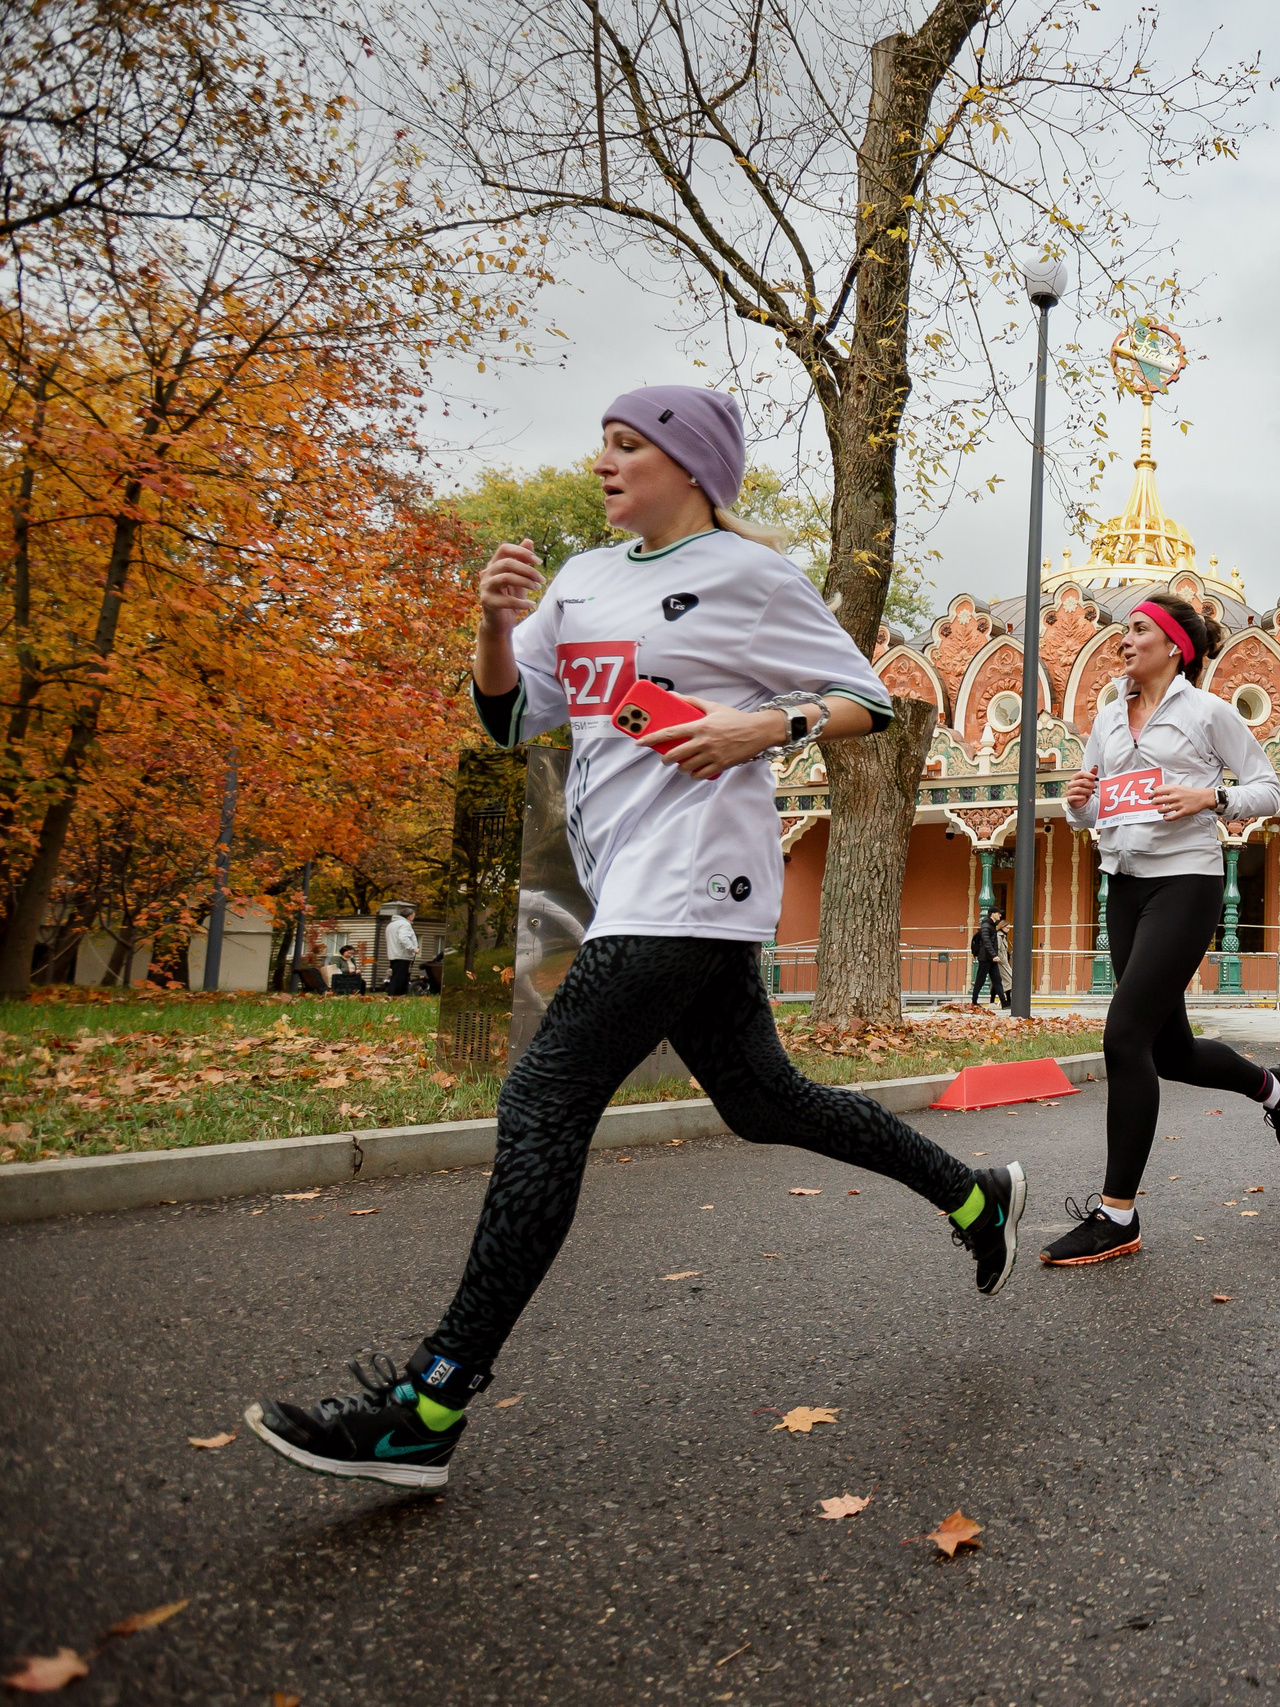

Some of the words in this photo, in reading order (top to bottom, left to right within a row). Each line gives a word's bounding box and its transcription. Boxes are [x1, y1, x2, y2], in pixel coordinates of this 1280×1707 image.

[559, 656, 625, 706] 427
[1103, 777, 1156, 812] 343
[430, 1363, 448, 1384] 427
